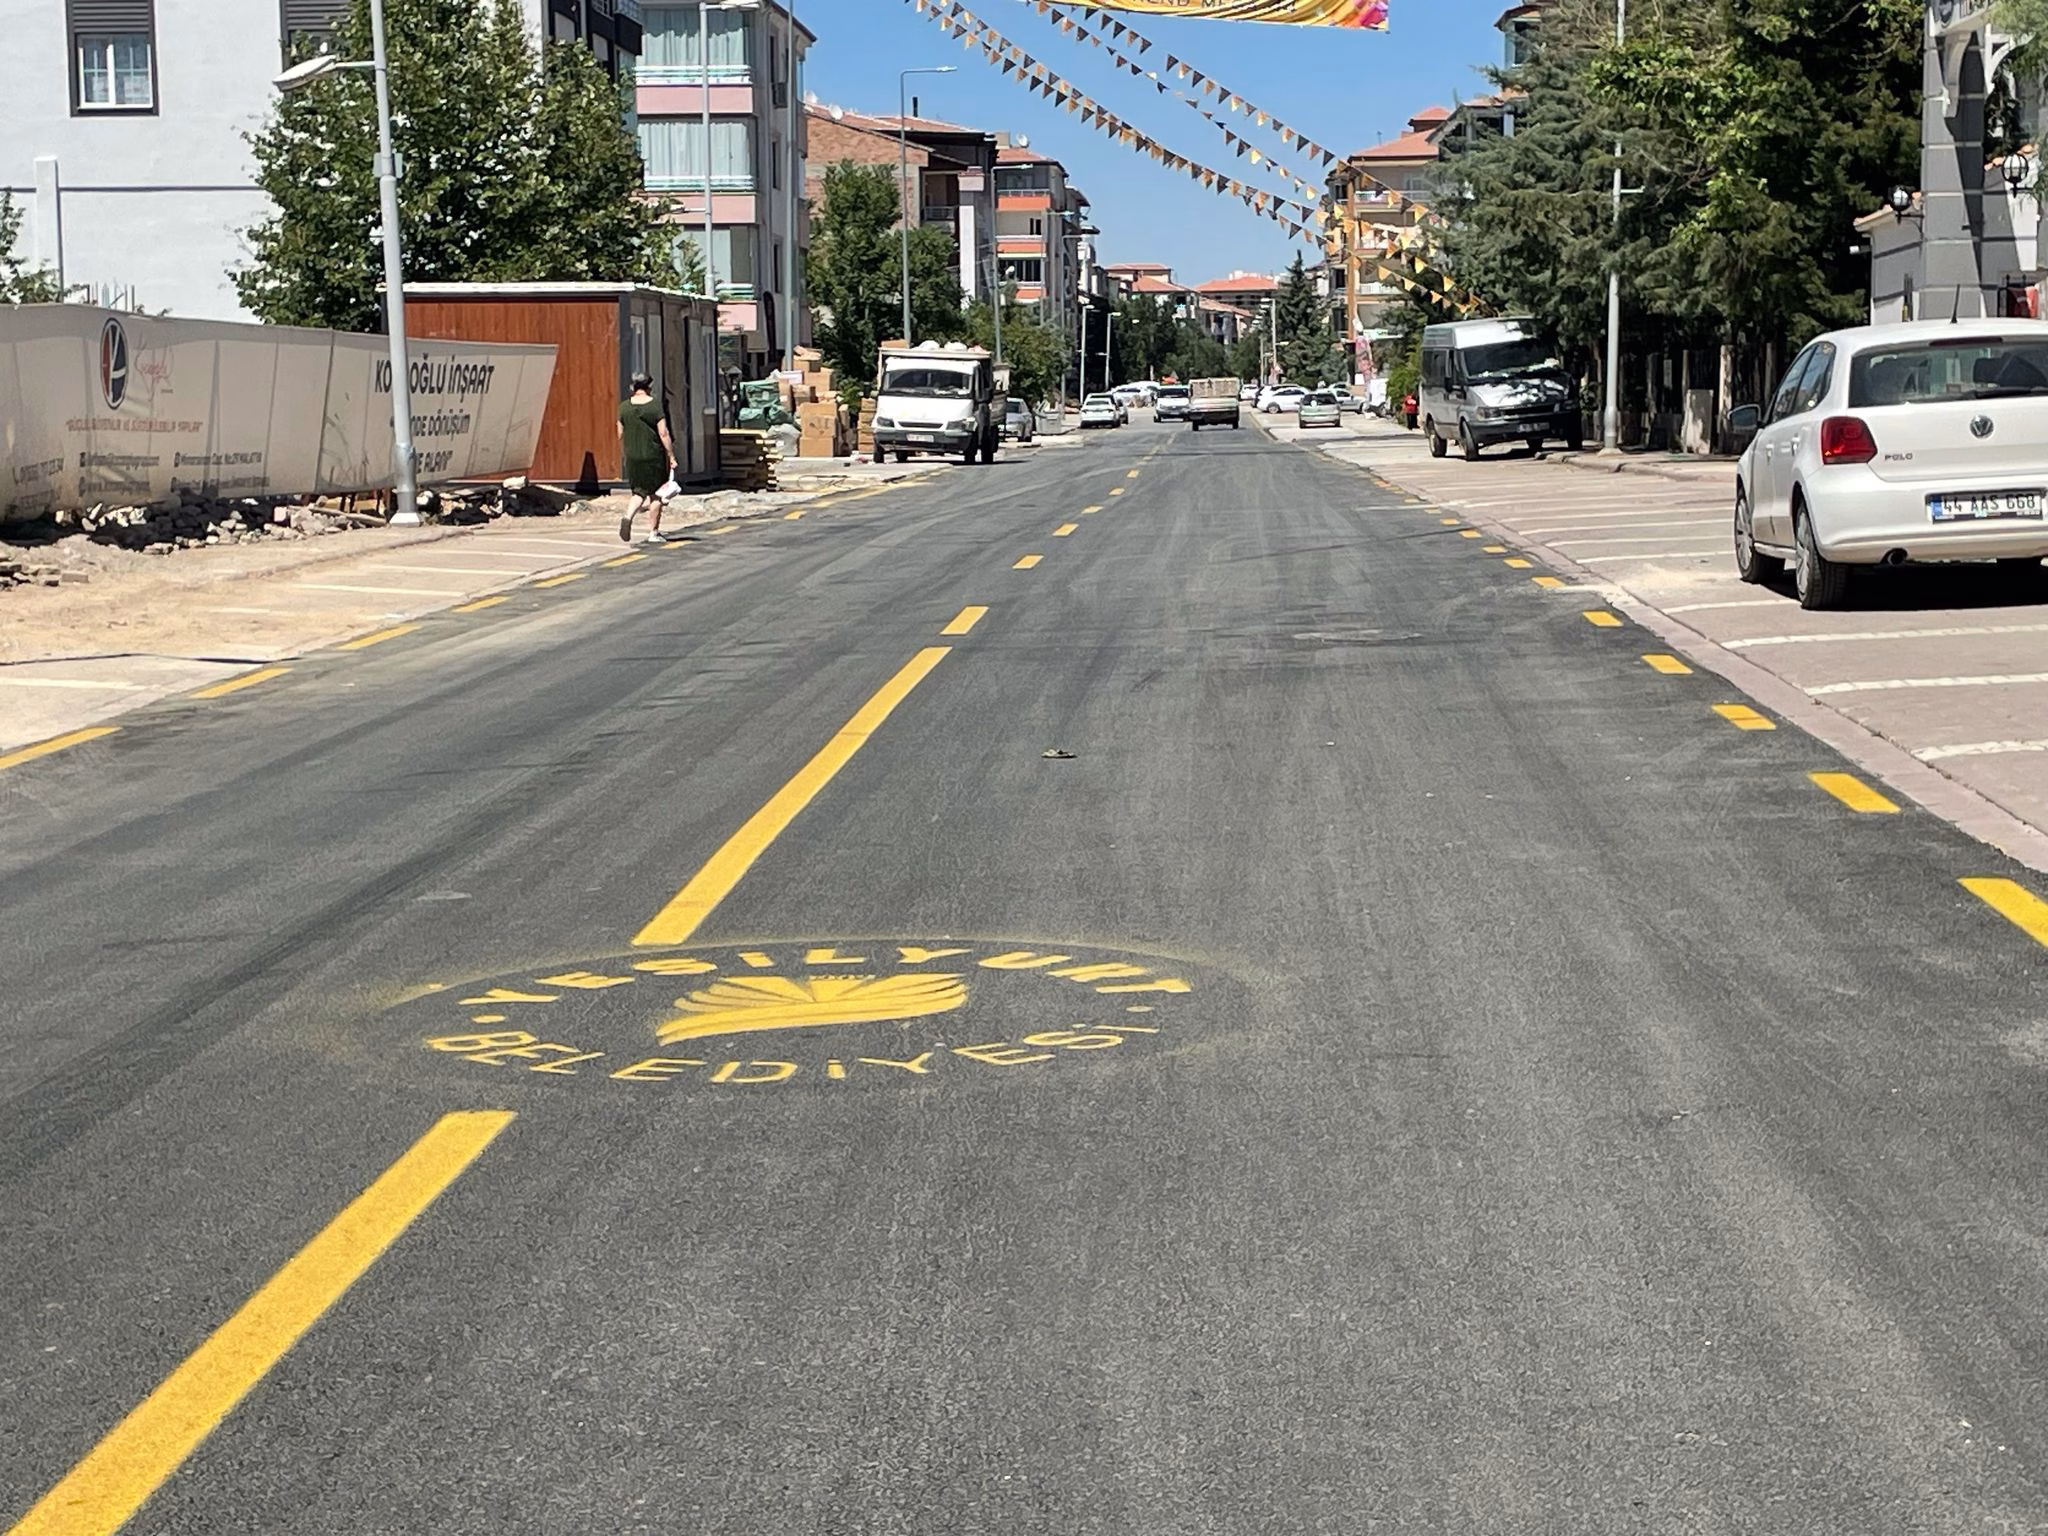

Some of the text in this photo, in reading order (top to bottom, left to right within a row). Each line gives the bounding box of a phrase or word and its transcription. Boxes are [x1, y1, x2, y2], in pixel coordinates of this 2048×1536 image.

[375, 353, 447, 394] KOOĞLU
[1884, 453, 1913, 461] POLO
[1943, 496, 1962, 513] 44
[1971, 495, 1999, 513] AAS
